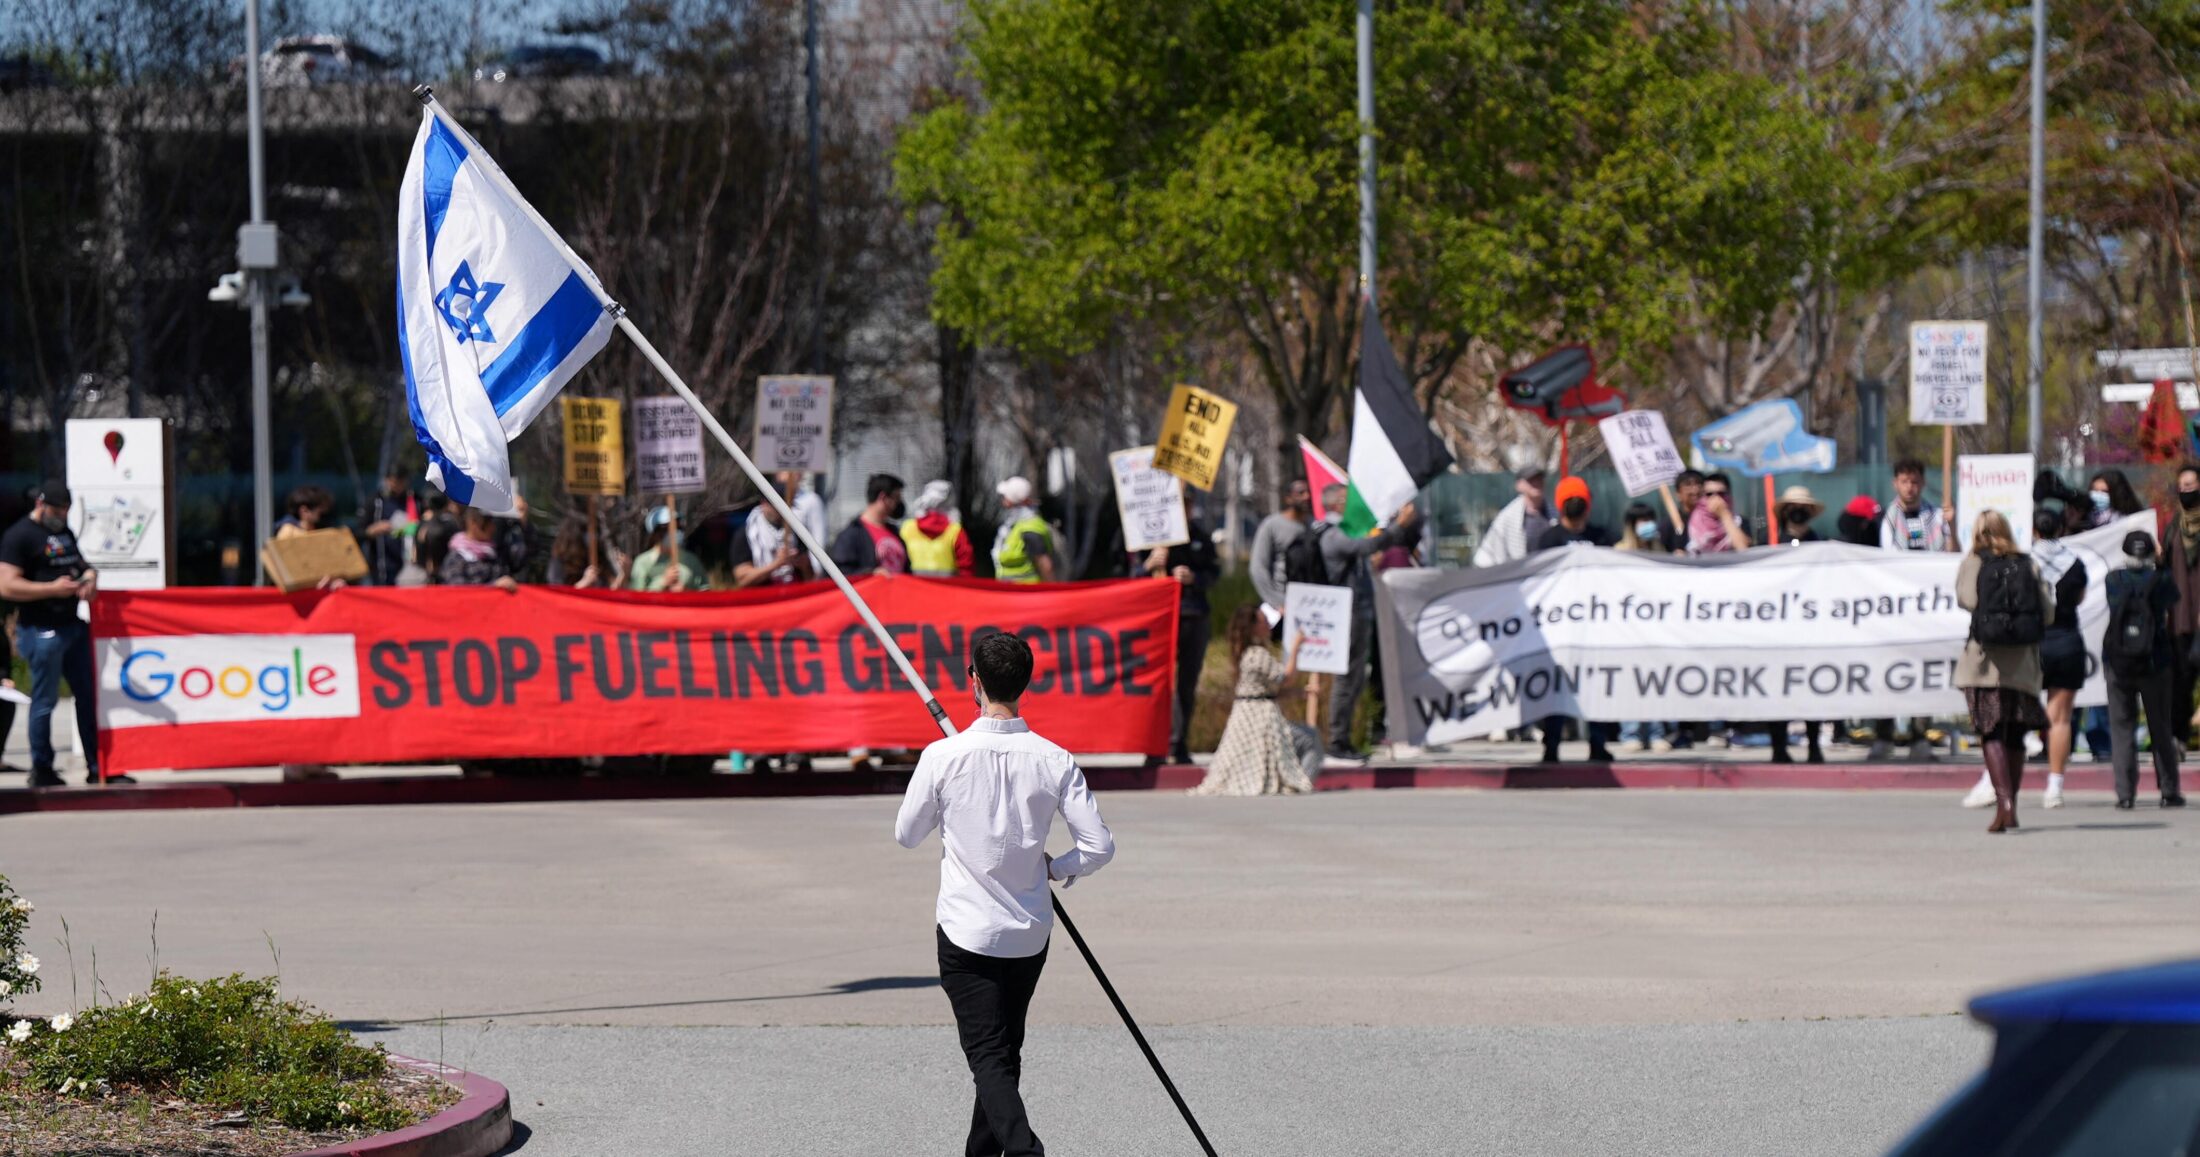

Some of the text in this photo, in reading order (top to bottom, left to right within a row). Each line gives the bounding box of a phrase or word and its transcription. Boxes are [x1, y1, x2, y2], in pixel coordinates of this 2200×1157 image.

[1185, 393, 1221, 425] END
[1959, 460, 2027, 489] Human
[1478, 586, 1952, 642] no tech for Israel's aparth
[119, 622, 1153, 712] Google STOP FUELING GENCIDE
[1414, 689, 1479, 728] WE
[1489, 663, 1623, 710] WON'T
[1632, 664, 1768, 698] WORK
[1783, 660, 1871, 697] FOR
